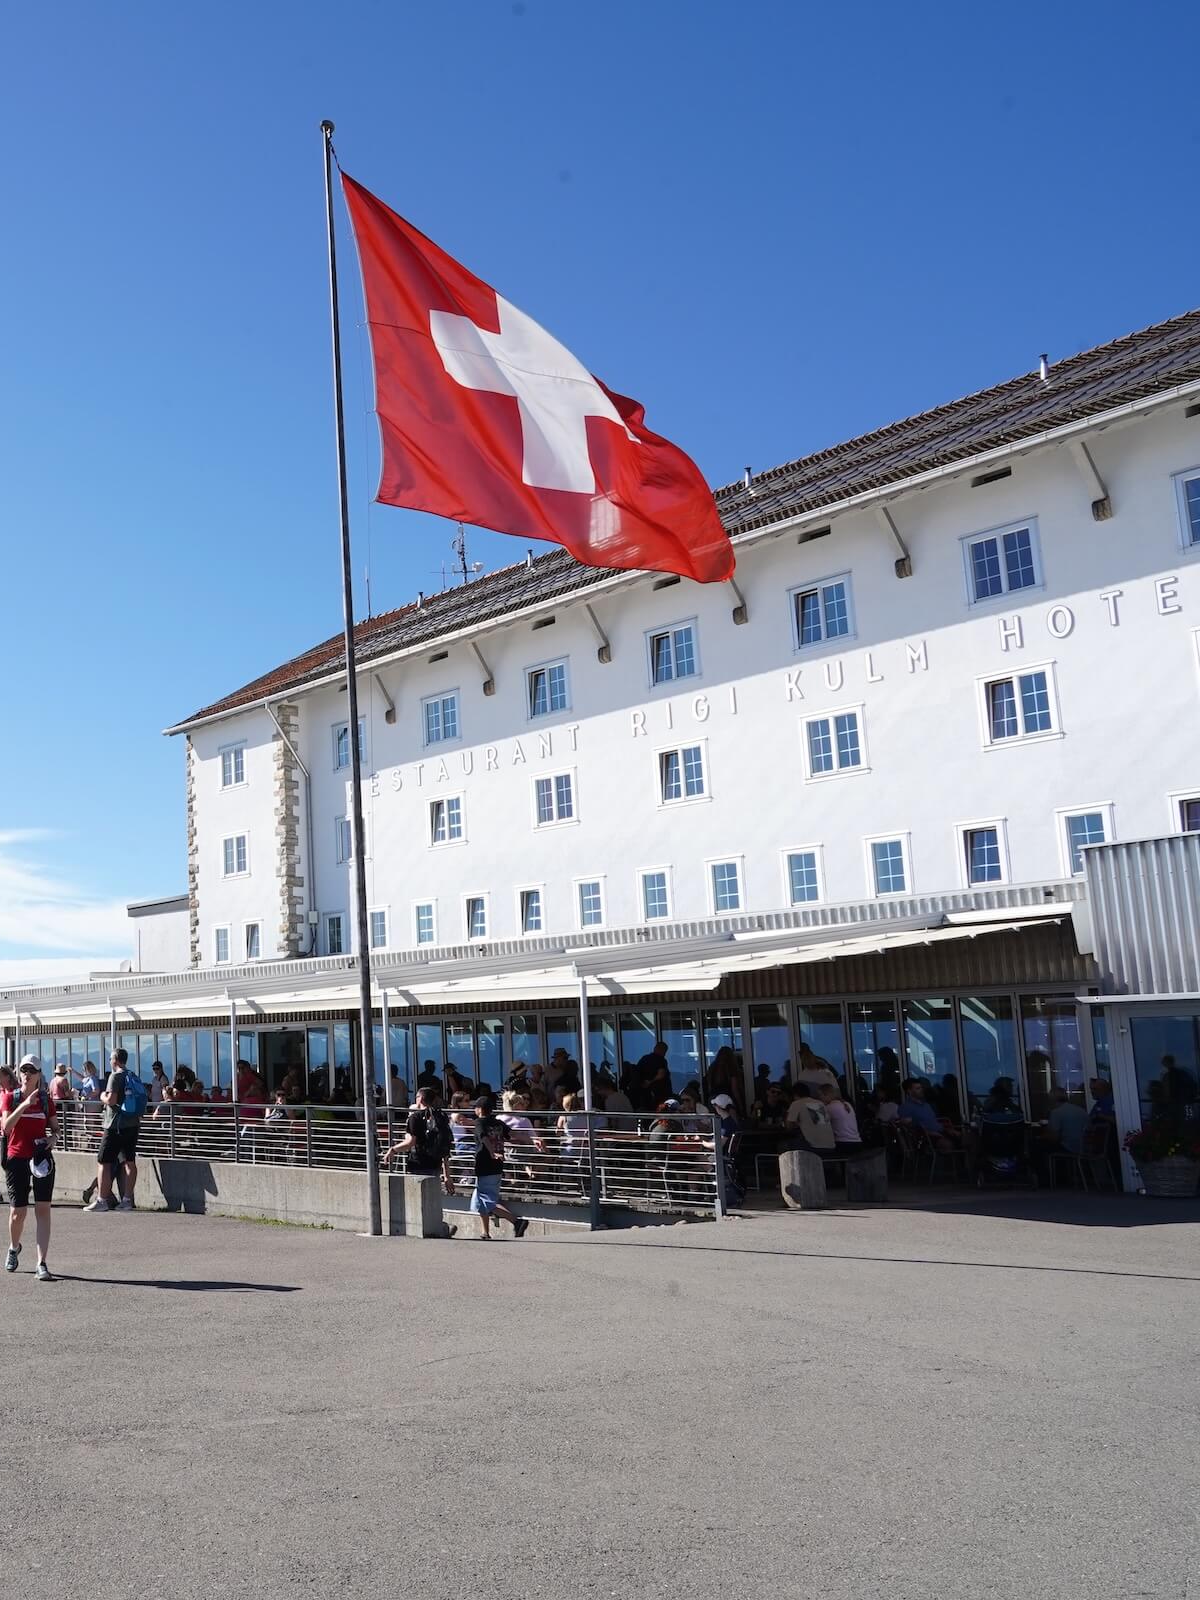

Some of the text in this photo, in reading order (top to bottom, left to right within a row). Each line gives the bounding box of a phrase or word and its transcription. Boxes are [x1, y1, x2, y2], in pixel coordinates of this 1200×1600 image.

[630, 687, 738, 737] RIGI
[784, 640, 928, 701] KULM
[999, 575, 1182, 652] HOTE
